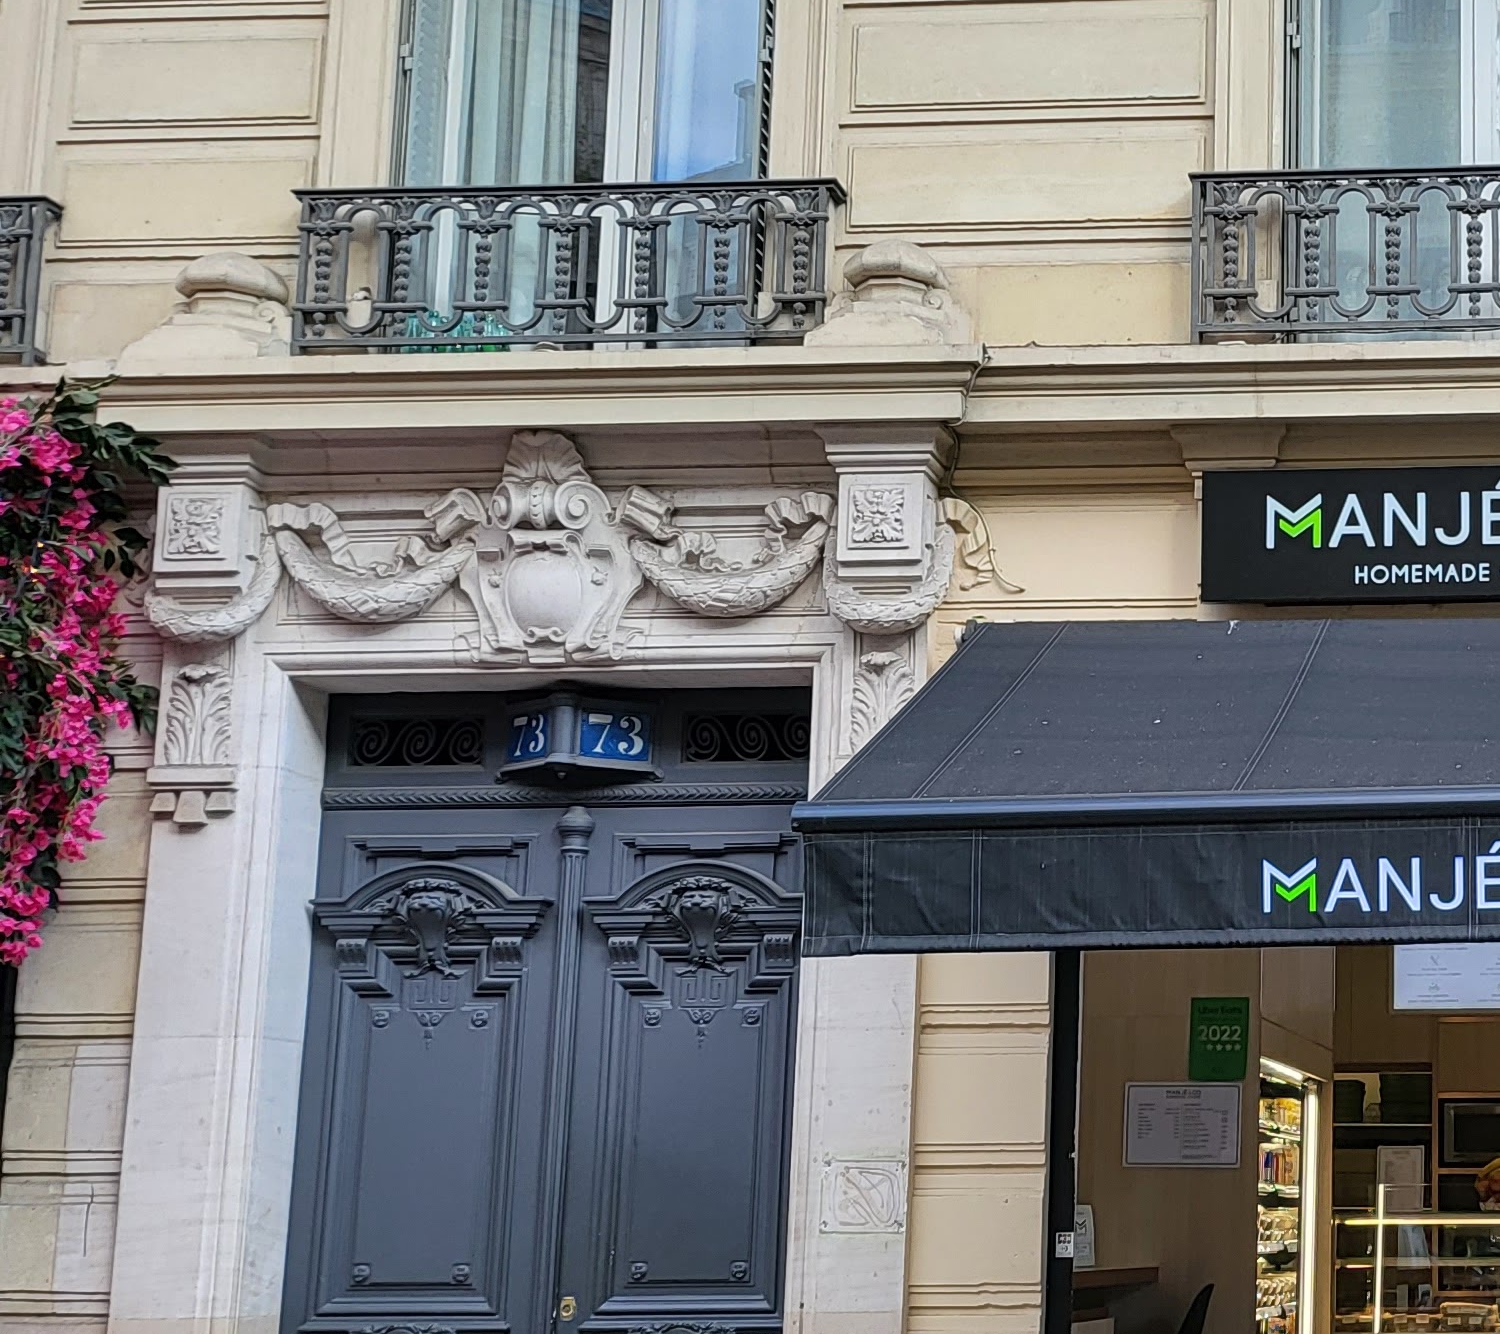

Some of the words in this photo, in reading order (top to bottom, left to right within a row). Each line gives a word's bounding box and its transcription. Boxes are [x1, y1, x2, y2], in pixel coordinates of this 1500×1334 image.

[1353, 563, 1490, 586] HOMEMADE
[513, 714, 545, 757] 73
[588, 713, 644, 756] 73
[1199, 1025, 1241, 1041] 2022
